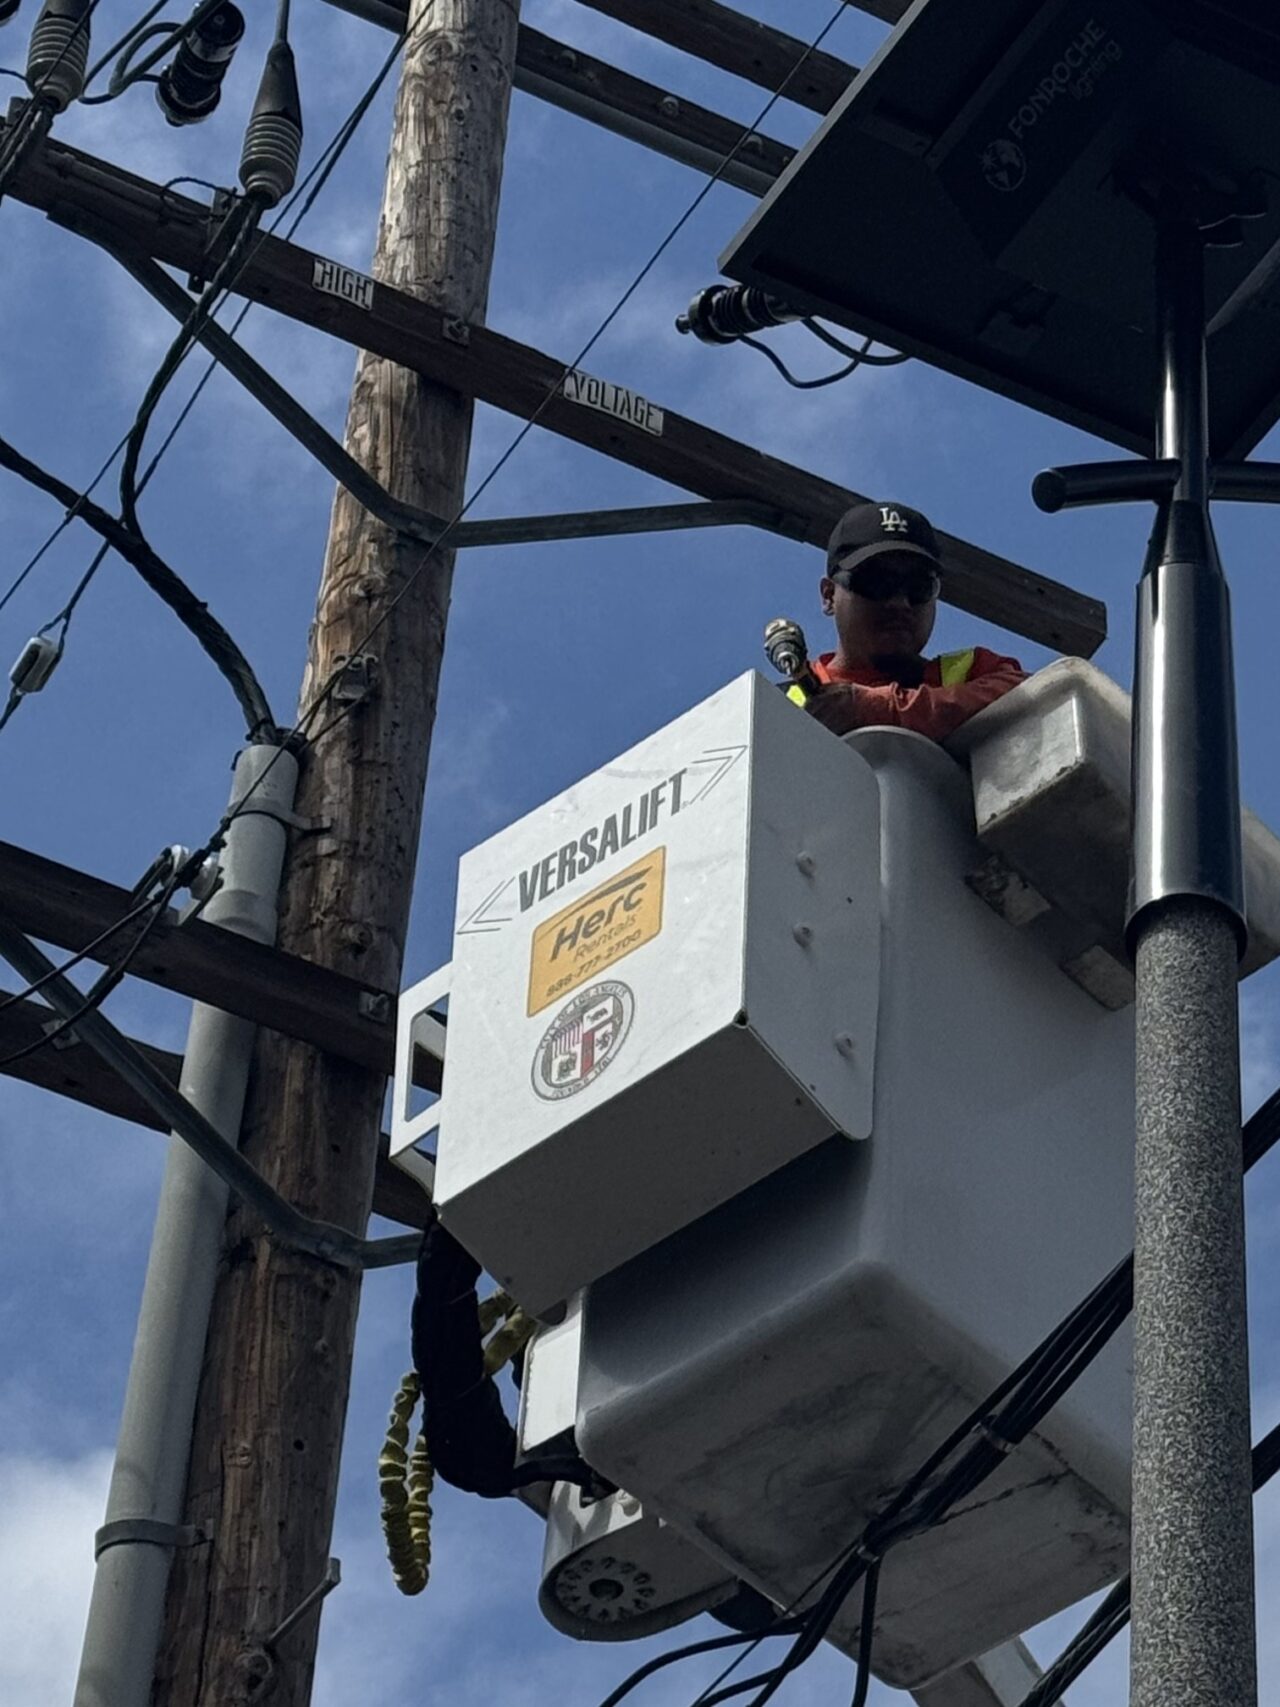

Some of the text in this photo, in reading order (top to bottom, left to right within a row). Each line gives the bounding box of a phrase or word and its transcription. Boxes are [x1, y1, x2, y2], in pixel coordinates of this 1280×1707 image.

[1008, 18, 1106, 138] FONROCHE
[317, 260, 661, 433] HIGH VOLTAGE
[878, 507, 908, 534] LA
[518, 768, 687, 911] VERSALIFT
[550, 882, 647, 962] Herc
[574, 914, 637, 962] Rentals
